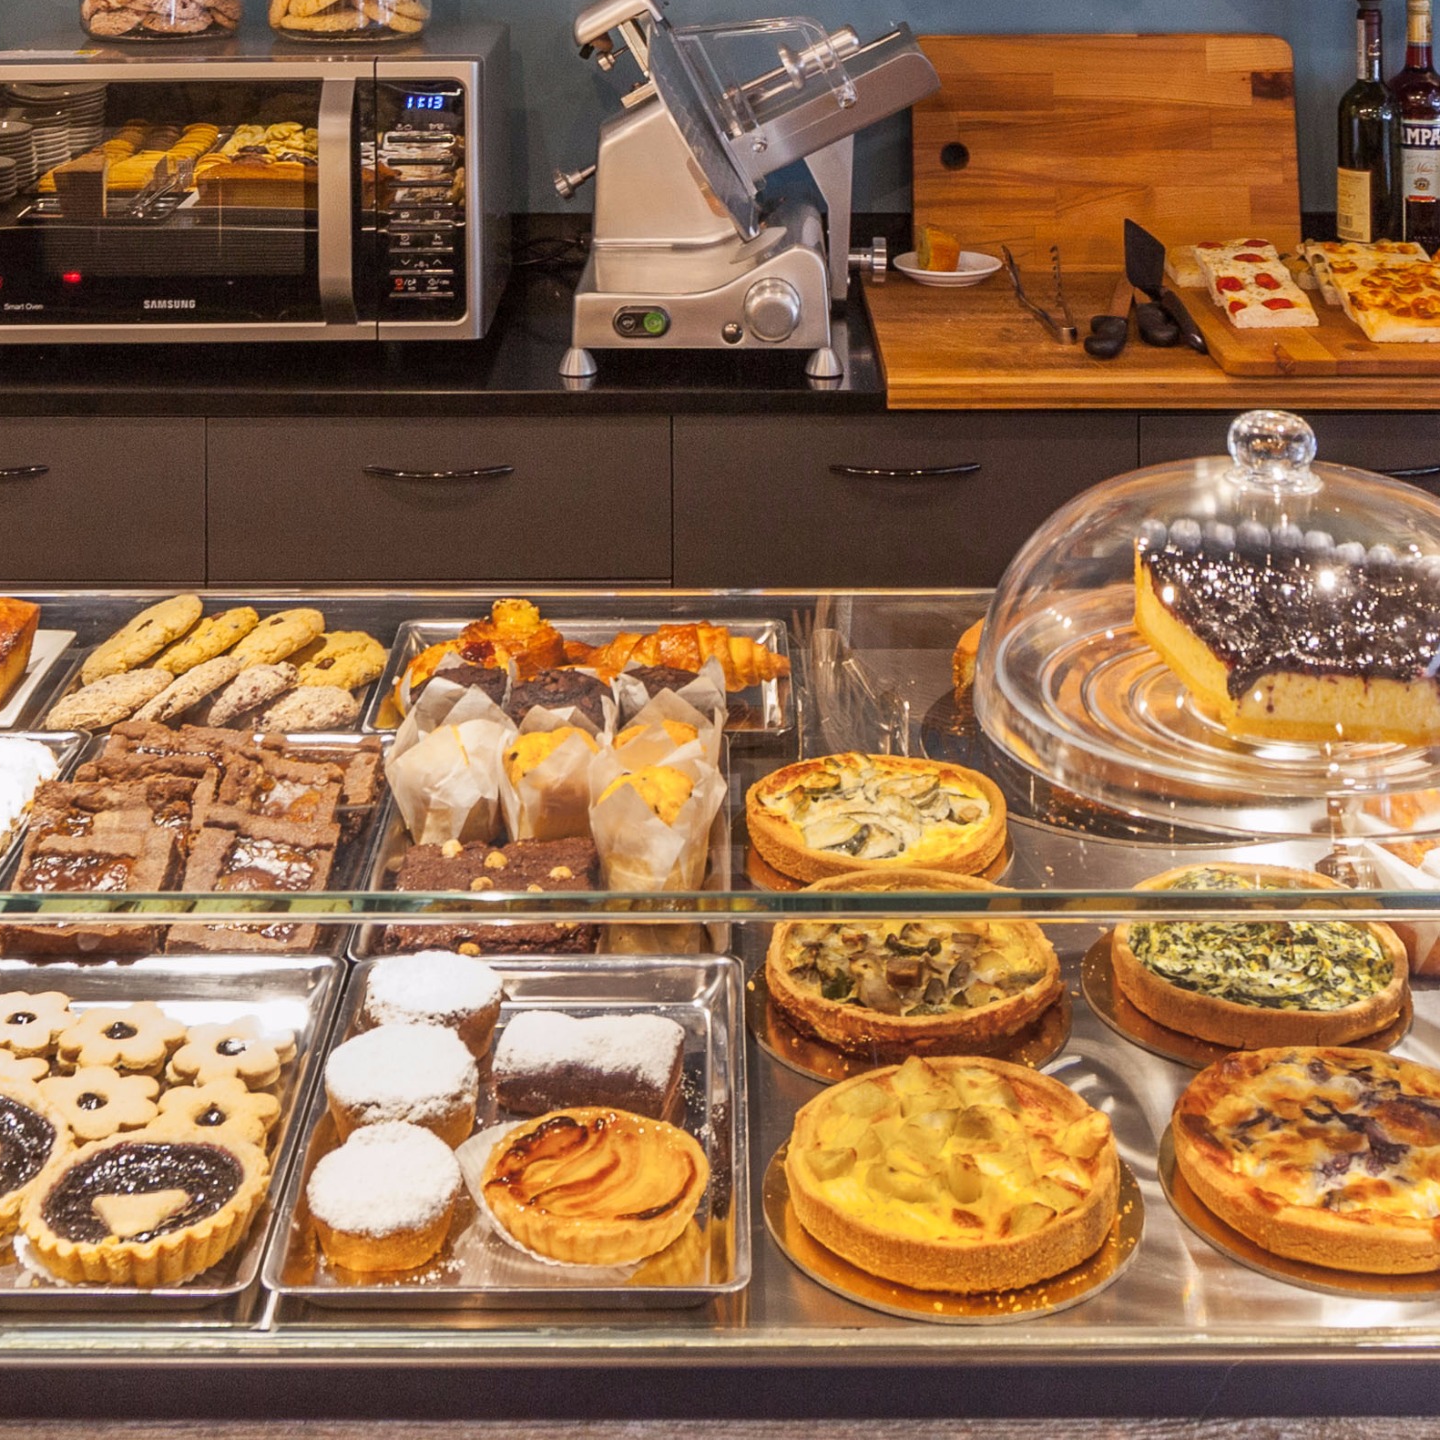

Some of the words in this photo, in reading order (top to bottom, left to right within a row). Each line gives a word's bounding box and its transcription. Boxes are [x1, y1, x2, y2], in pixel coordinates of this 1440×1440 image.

[3, 303, 24, 311] Smart
[25, 303, 44, 311] Oven
[143, 300, 196, 309] SAMSUNG
